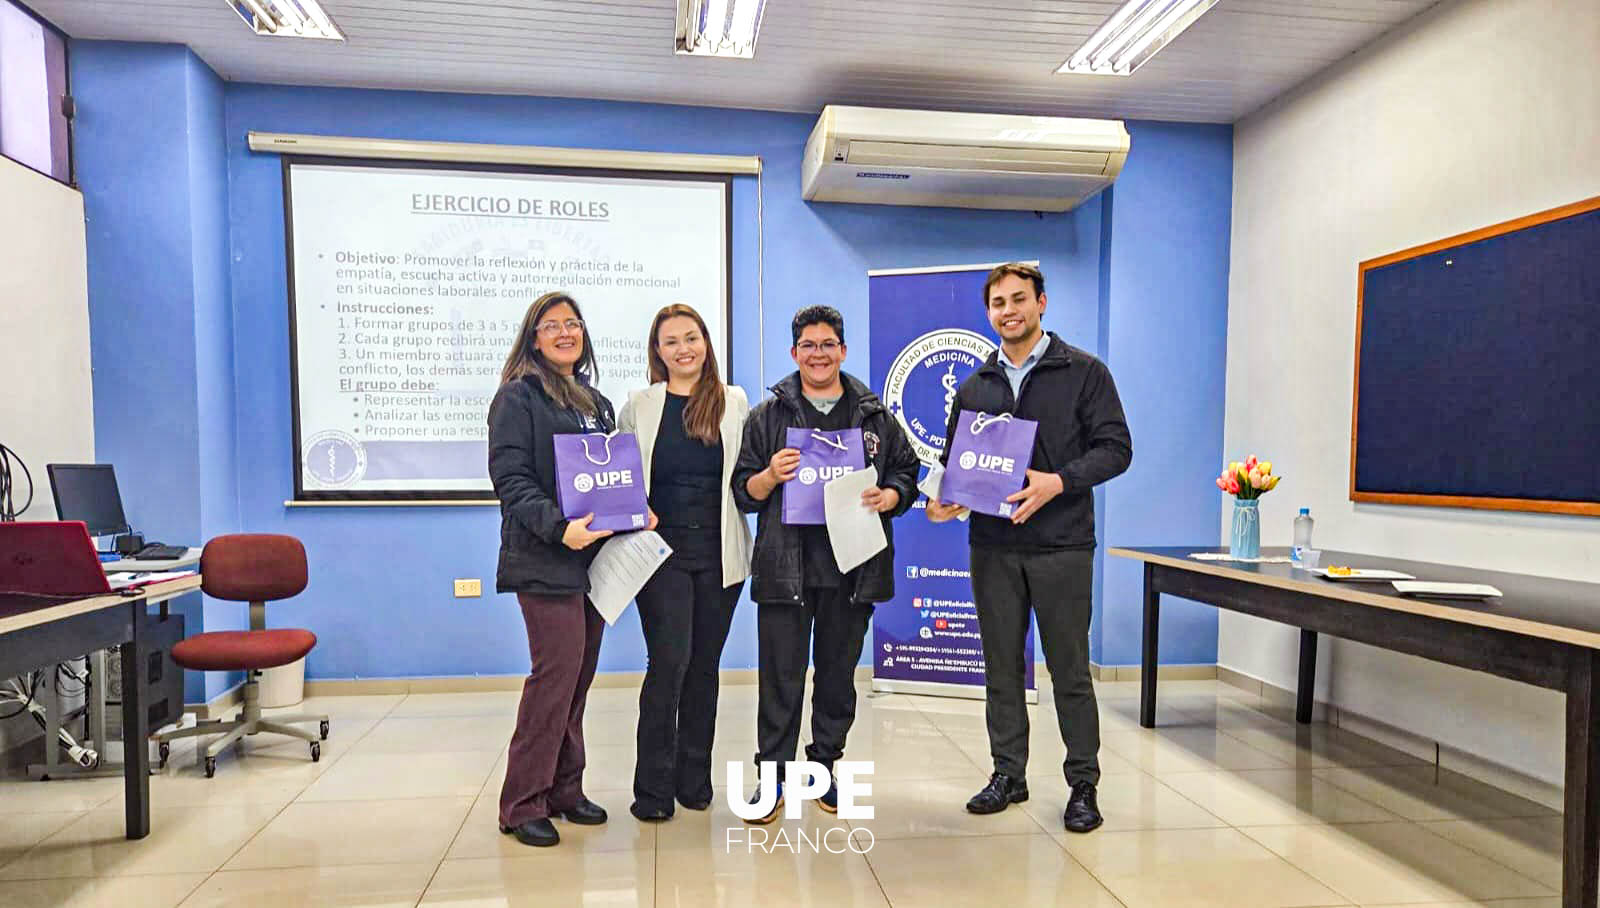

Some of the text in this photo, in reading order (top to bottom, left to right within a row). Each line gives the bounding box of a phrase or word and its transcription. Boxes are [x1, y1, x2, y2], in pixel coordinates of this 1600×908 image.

[412, 194, 609, 217] EJERCICIO DE ROLES
[335, 251, 644, 272] Objetivo: Promover la reflexión y práctica de la
[336, 267, 681, 289] empatía, escucha activa y autorregulación emocional
[336, 284, 353, 294] en
[358, 282, 434, 296] situaciones
[438, 284, 497, 297] laborales
[337, 300, 434, 315] Instrucciones:
[339, 317, 350, 329] 1.
[355, 317, 404, 330] Formar
[408, 320, 454, 332] grupos
[458, 319, 474, 331] de
[478, 320, 485, 331] 3
[489, 322, 497, 331] a
[501, 321, 509, 331] 5
[339, 332, 350, 345] 2.
[355, 333, 389, 345] Cada
[393, 335, 433, 347] grupo
[437, 334, 486, 346] recibirá
[339, 348, 352, 360] 3.
[356, 348, 375, 360] Un
[379, 349, 441, 361] miembro
[445, 350, 493, 361] actuará
[924, 351, 976, 369] MEDICINA
[340, 363, 402, 378] conflicto,
[406, 364, 425, 376] los
[891, 349, 921, 395] FACULTAD
[921, 341, 936, 353] DE
[937, 337, 984, 354] CIENCIAS
[340, 379, 440, 392] El grupo debe:
[364, 394, 444, 407] Representar
[449, 395, 461, 406] la
[365, 409, 418, 421] Analizar
[423, 410, 440, 421] las
[365, 424, 428, 438] Proponer
[432, 427, 457, 436] una
[910, 417, 927, 438] UPE
[978, 453, 1015, 473] UPE
[595, 470, 633, 487] UPE
